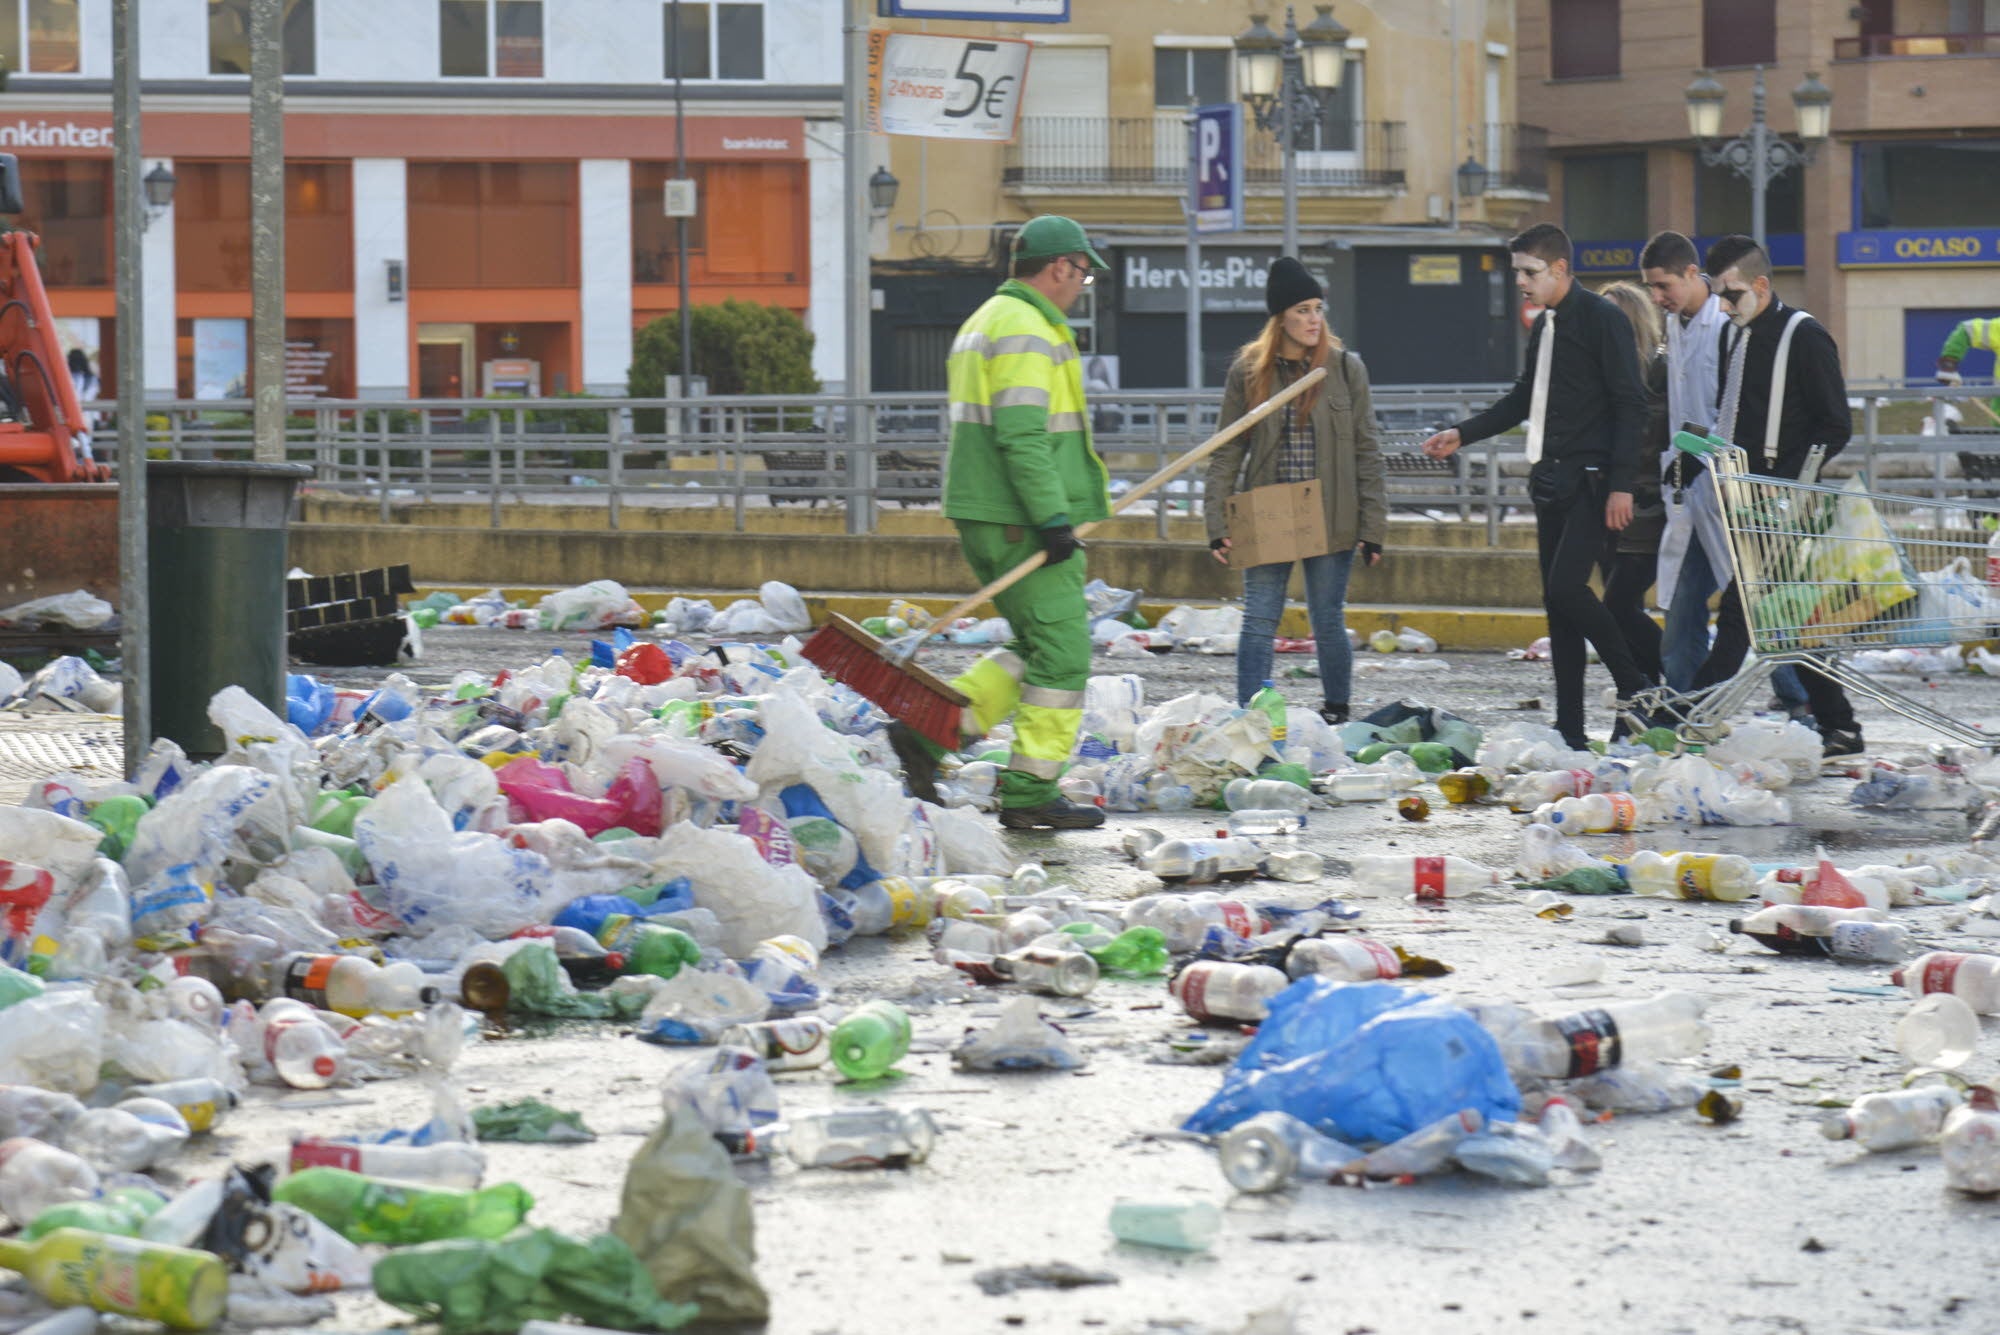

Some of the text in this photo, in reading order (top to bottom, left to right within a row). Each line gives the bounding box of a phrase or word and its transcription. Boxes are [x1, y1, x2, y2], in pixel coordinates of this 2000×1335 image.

[887, 80, 945, 100] 24horas
[943, 42, 1016, 119] 5€
[1581, 248, 1634, 267] OCASO
[1895, 237, 1981, 258] OCASO
